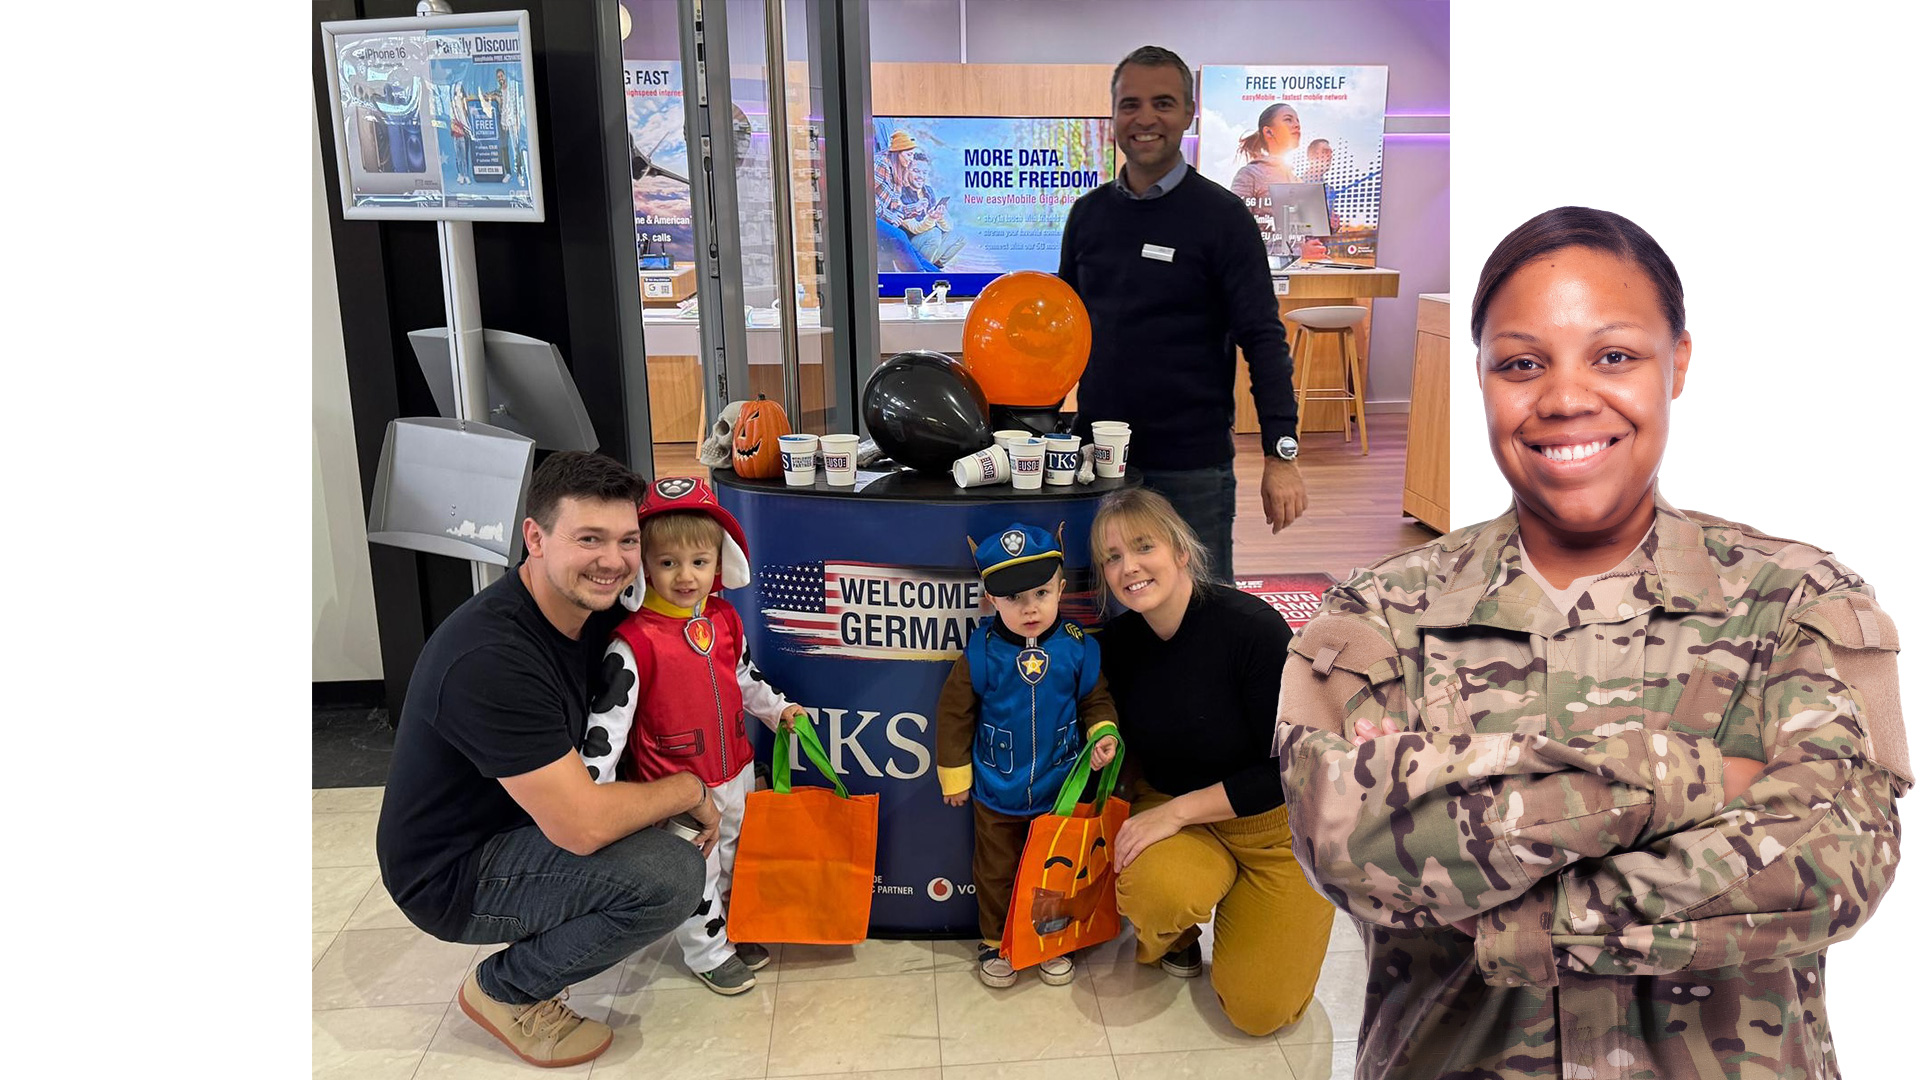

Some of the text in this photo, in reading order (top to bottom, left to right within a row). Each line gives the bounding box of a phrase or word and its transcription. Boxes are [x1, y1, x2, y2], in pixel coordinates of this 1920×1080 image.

[436, 36, 520, 56] Family Discoun
[365, 47, 407, 59] iPhone 16
[636, 70, 669, 85] FAST
[1245, 76, 1346, 90] FREE YOURSELF
[1242, 94, 1275, 102] easyMobile
[1282, 93, 1302, 101] fastest
[1303, 93, 1323, 101] mobile
[1324, 93, 1347, 101] network
[475, 119, 495, 130] FREE
[964, 149, 1064, 167] MORE DATA.
[964, 171, 1098, 188] MORE FREEDOM
[964, 194, 1076, 205] New easyMobile Giga pla
[646, 214, 653, 225] &
[654, 214, 690, 225] American
[652, 233, 672, 242] calls
[829, 458, 843, 468] USO
[1021, 460, 1037, 471] USO
[1046, 452, 1077, 469] TKS
[839, 577, 979, 610] WELCOME
[877, 885, 914, 895] PARTNER
[957, 884, 977, 895] VO
